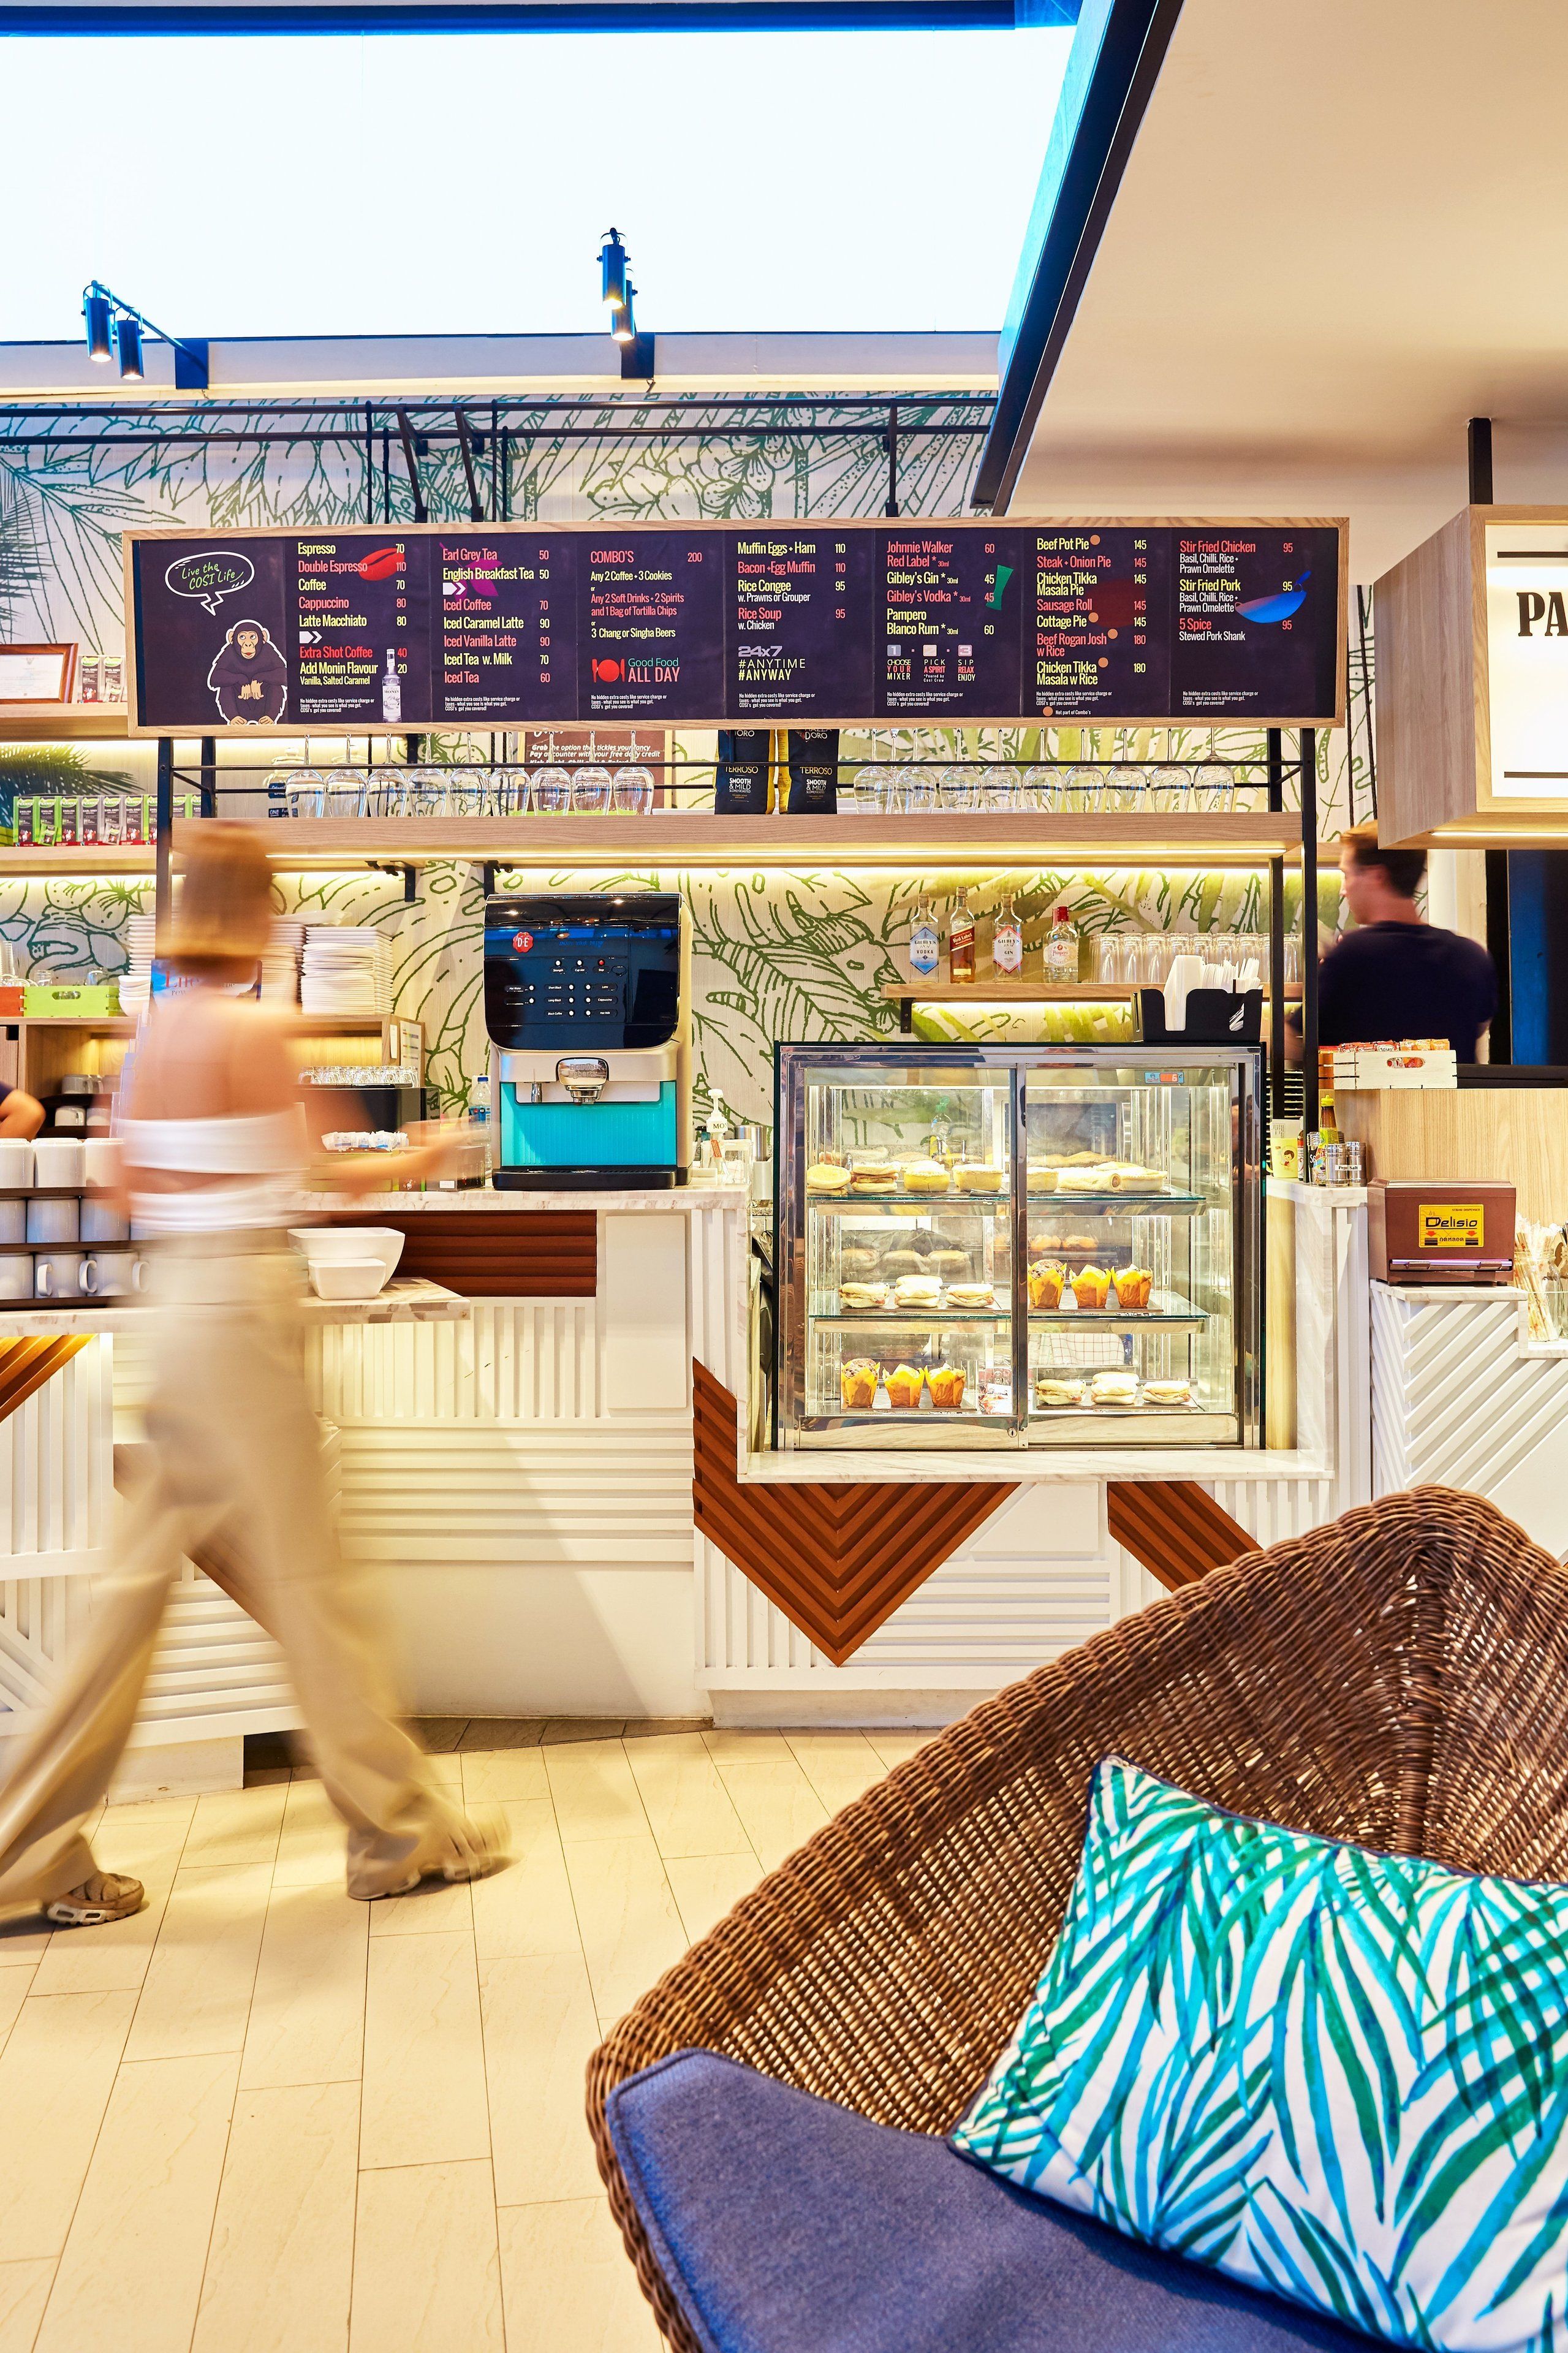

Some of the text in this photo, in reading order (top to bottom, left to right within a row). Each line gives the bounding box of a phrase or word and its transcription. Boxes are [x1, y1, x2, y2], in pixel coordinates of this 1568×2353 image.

[298, 542, 404, 556] Espresso 70
[738, 542, 766, 554] Muffin
[768, 542, 787, 556] Eggs
[795, 542, 816, 553] Ham
[835, 544, 846, 553] 110
[887, 541, 994, 553] Johnnie Walker 60
[1037, 538, 1146, 550] Beef Pot Pie 145
[1180, 540, 1293, 553] Stir Fried Chicken 95
[443, 548, 549, 562] Earl Grey Tea 50
[591, 551, 702, 563] COMBO'S 200
[182, 562, 218, 579] Live the
[298, 560, 406, 574] Double Espresso 110
[1180, 564, 1235, 573] Prawn Omelette
[189, 569, 236, 589] COSI Life
[443, 567, 549, 582] English Breakfast Tea 50
[298, 578, 405, 591] Coffee 70
[738, 580, 845, 593] Rice Congee 95
[299, 597, 406, 610] Cappuccino 80
[444, 599, 548, 611] Iced Coffee 70
[1037, 599, 1146, 613] Sausage Roll 145
[444, 616, 550, 629] Iced Caramel Latte 90
[1037, 615, 1146, 629] Cottage Pie 145
[1180, 618, 1292, 632] 5 Spice 95
[1180, 631, 1245, 640] Stewed Pork Shank
[300, 646, 407, 658] Extra Shot Coffee 40
[738, 646, 782, 657] 24x7
[300, 662, 407, 674] Add Monin Flavour 20
[628, 657, 678, 667] Good Food
[739, 659, 805, 669] #ANYTIME
[300, 676, 369, 686] Vanilla, Salted Caramel
[628, 667, 680, 683] ALL DAY
[739, 669, 791, 681] #ANYWAY
[800, 767, 832, 775] TERROSO
[1426, 1216, 1477, 1227] Delisio
